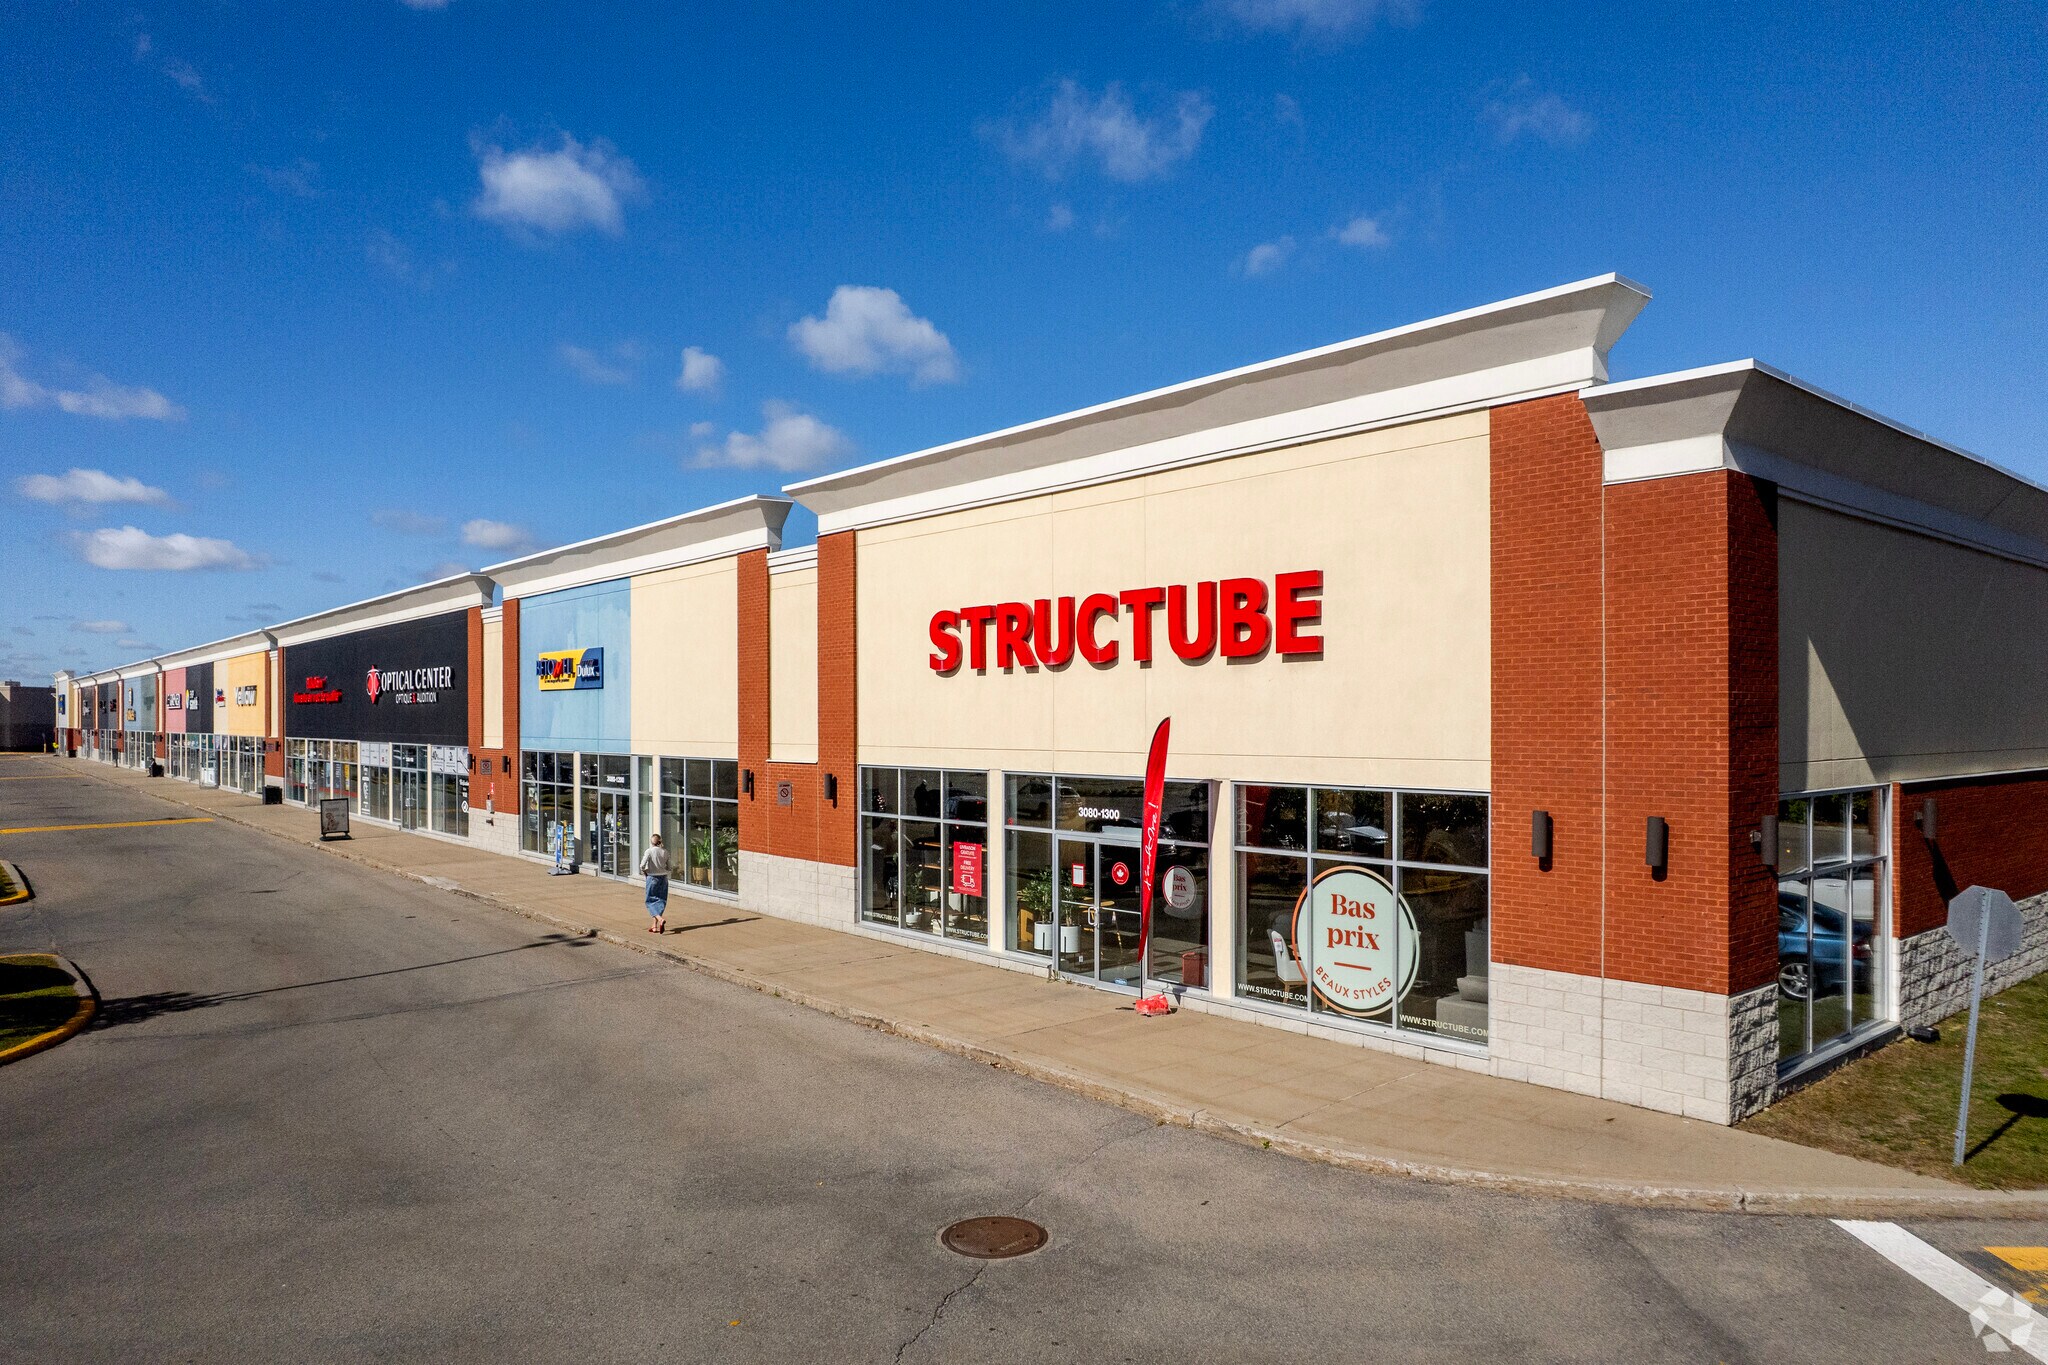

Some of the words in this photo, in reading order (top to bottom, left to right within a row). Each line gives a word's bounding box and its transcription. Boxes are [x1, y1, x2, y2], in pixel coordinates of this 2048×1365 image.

[929, 569, 1324, 673] STRUCTUBE
[381, 669, 415, 692] OPTICAL
[415, 666, 452, 690] CENTER
[577, 664, 595, 678] Dulux
[395, 693, 412, 704] OPTIQUE
[417, 692, 437, 703] AUDITION
[1078, 806, 1120, 820] 3080-1300
[1172, 883, 1187, 892] prix
[1330, 893, 1376, 920] Bas
[945, 926, 988, 940] WWW.STRUCTUBE.CO
[1326, 925, 1380, 951] prix
[1315, 965, 1350, 999] BEAUX
[1353, 977, 1392, 1000] STYLES
